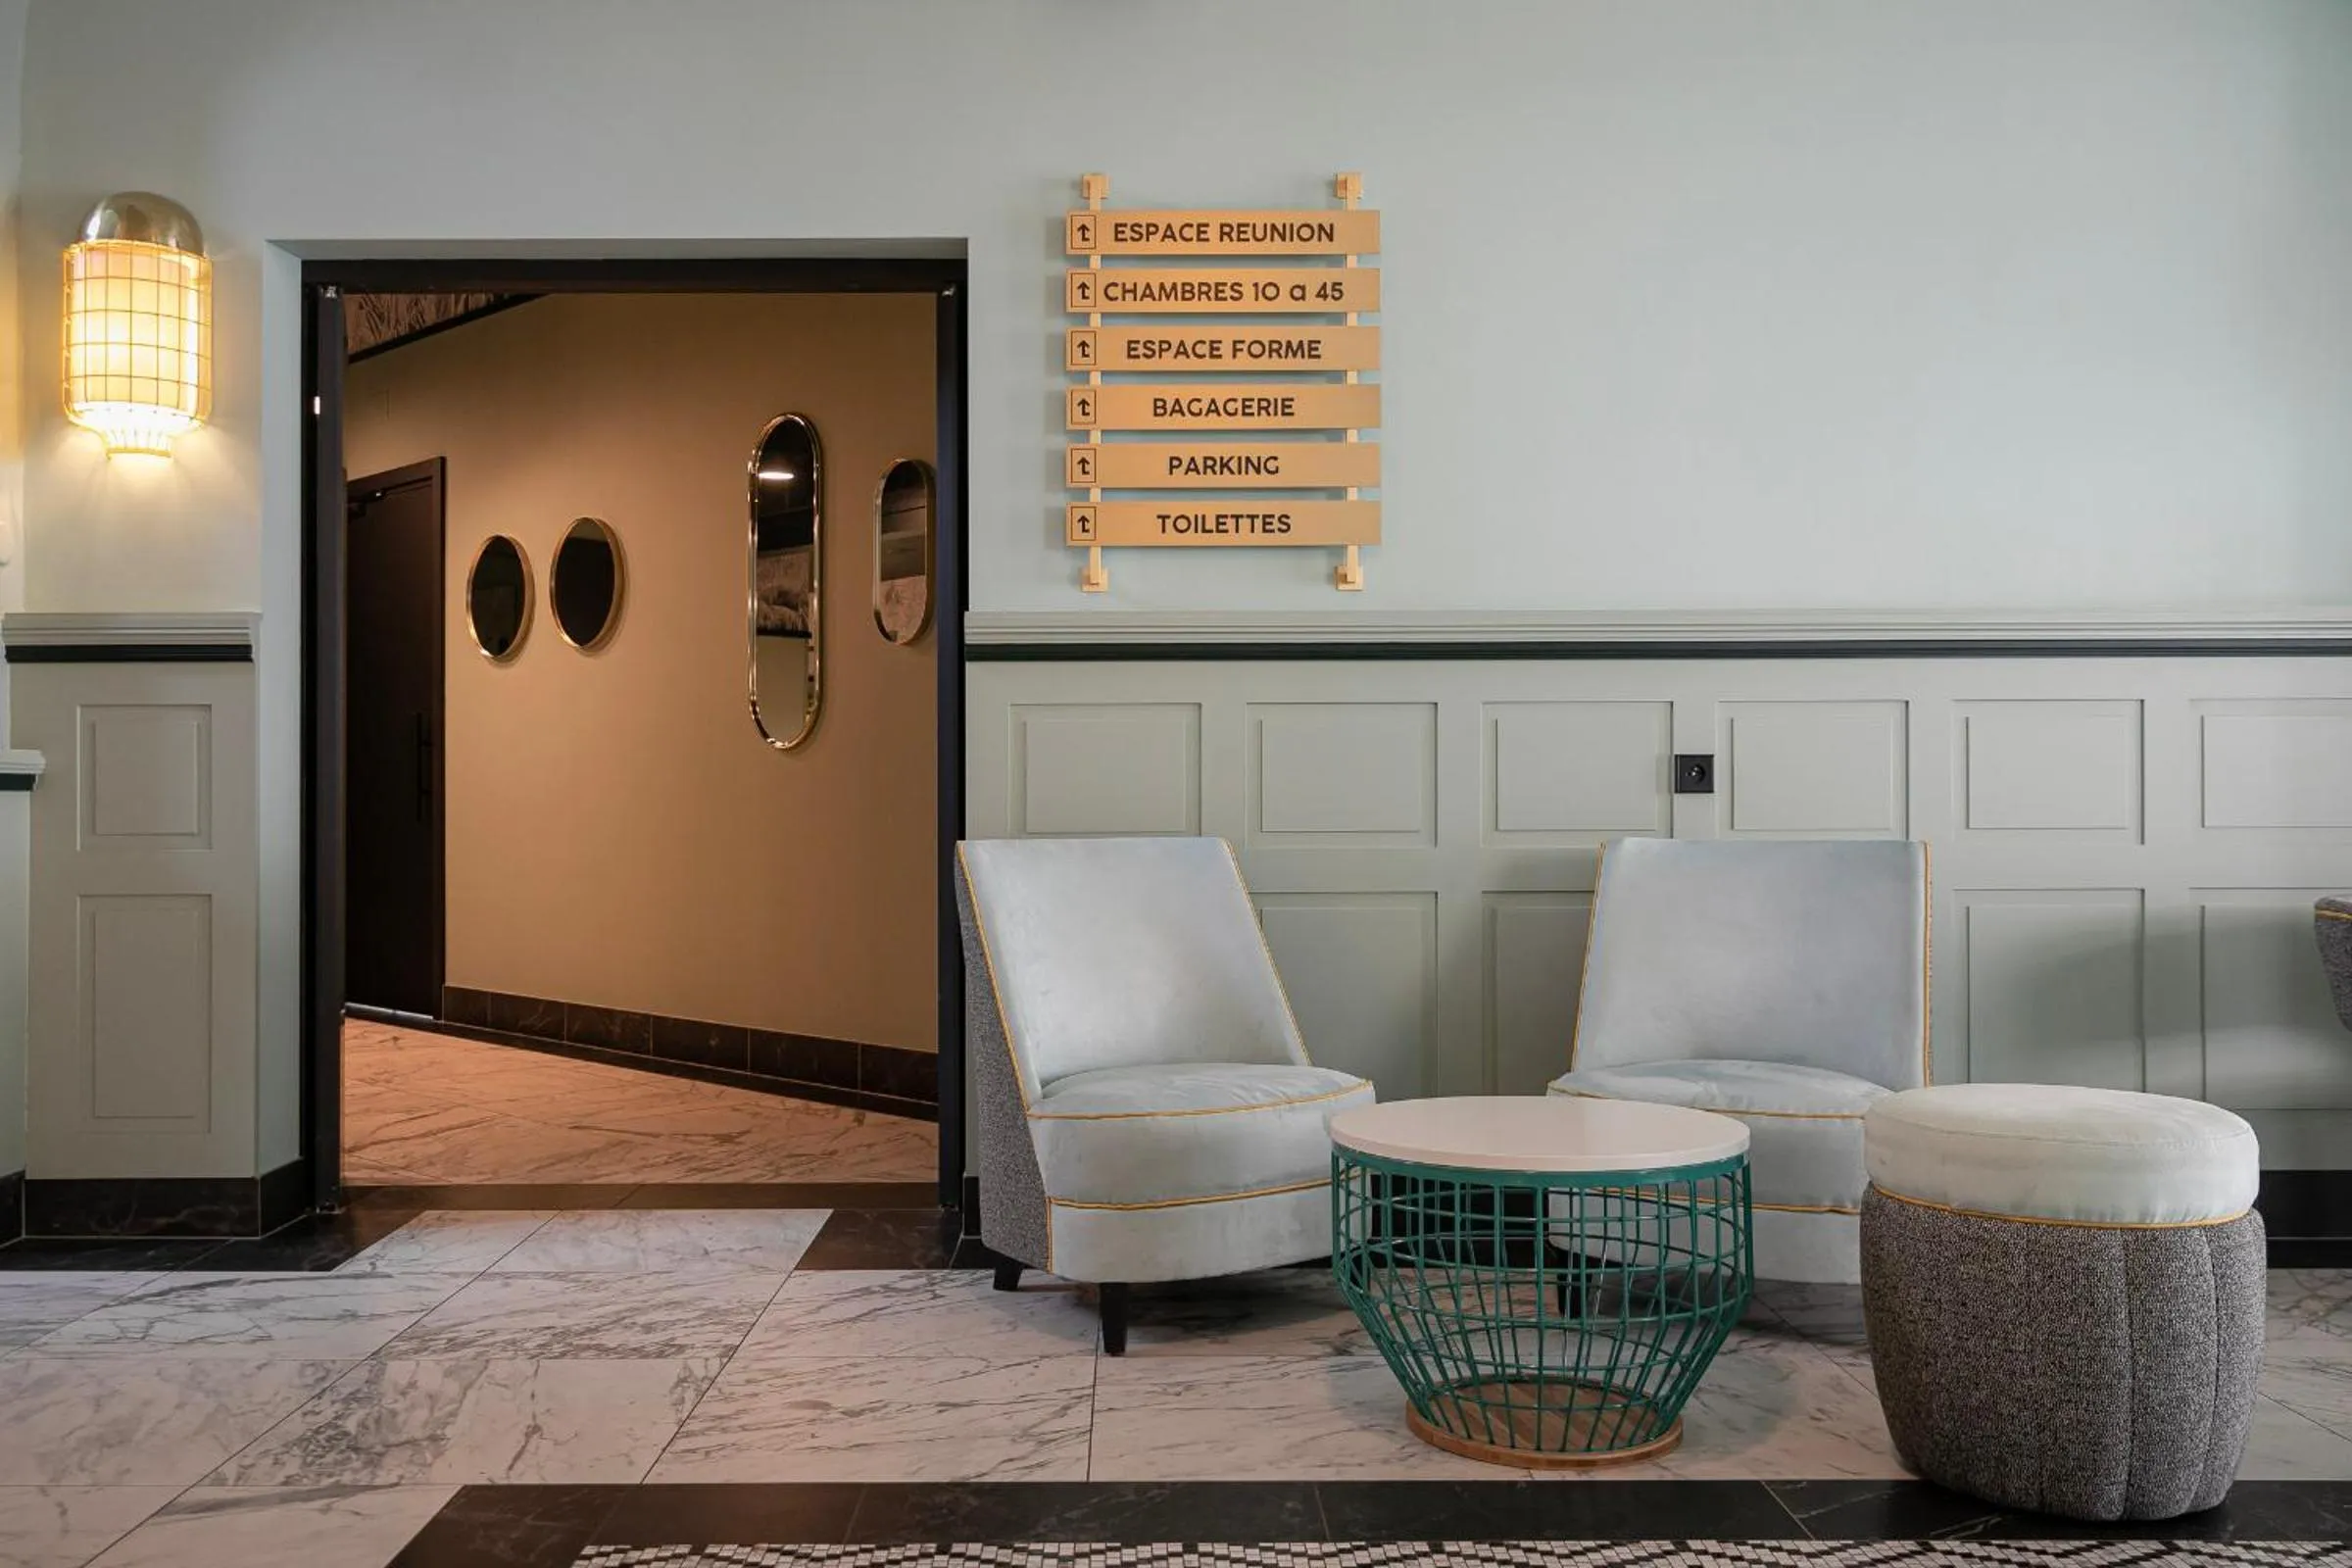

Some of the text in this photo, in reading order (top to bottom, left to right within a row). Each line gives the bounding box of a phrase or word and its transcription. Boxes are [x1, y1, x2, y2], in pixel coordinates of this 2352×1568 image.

[1113, 221, 1335, 243] ESPACE REUNION
[1102, 281, 1245, 303] CHAMBRES
[1251, 281, 1281, 302] 10
[1314, 281, 1345, 302] 45
[1126, 339, 1322, 361] ESPACE FORME
[1152, 397, 1296, 417] BAGAGERIE
[1168, 455, 1280, 476] PARKING
[1155, 513, 1292, 535] TOILETTES
